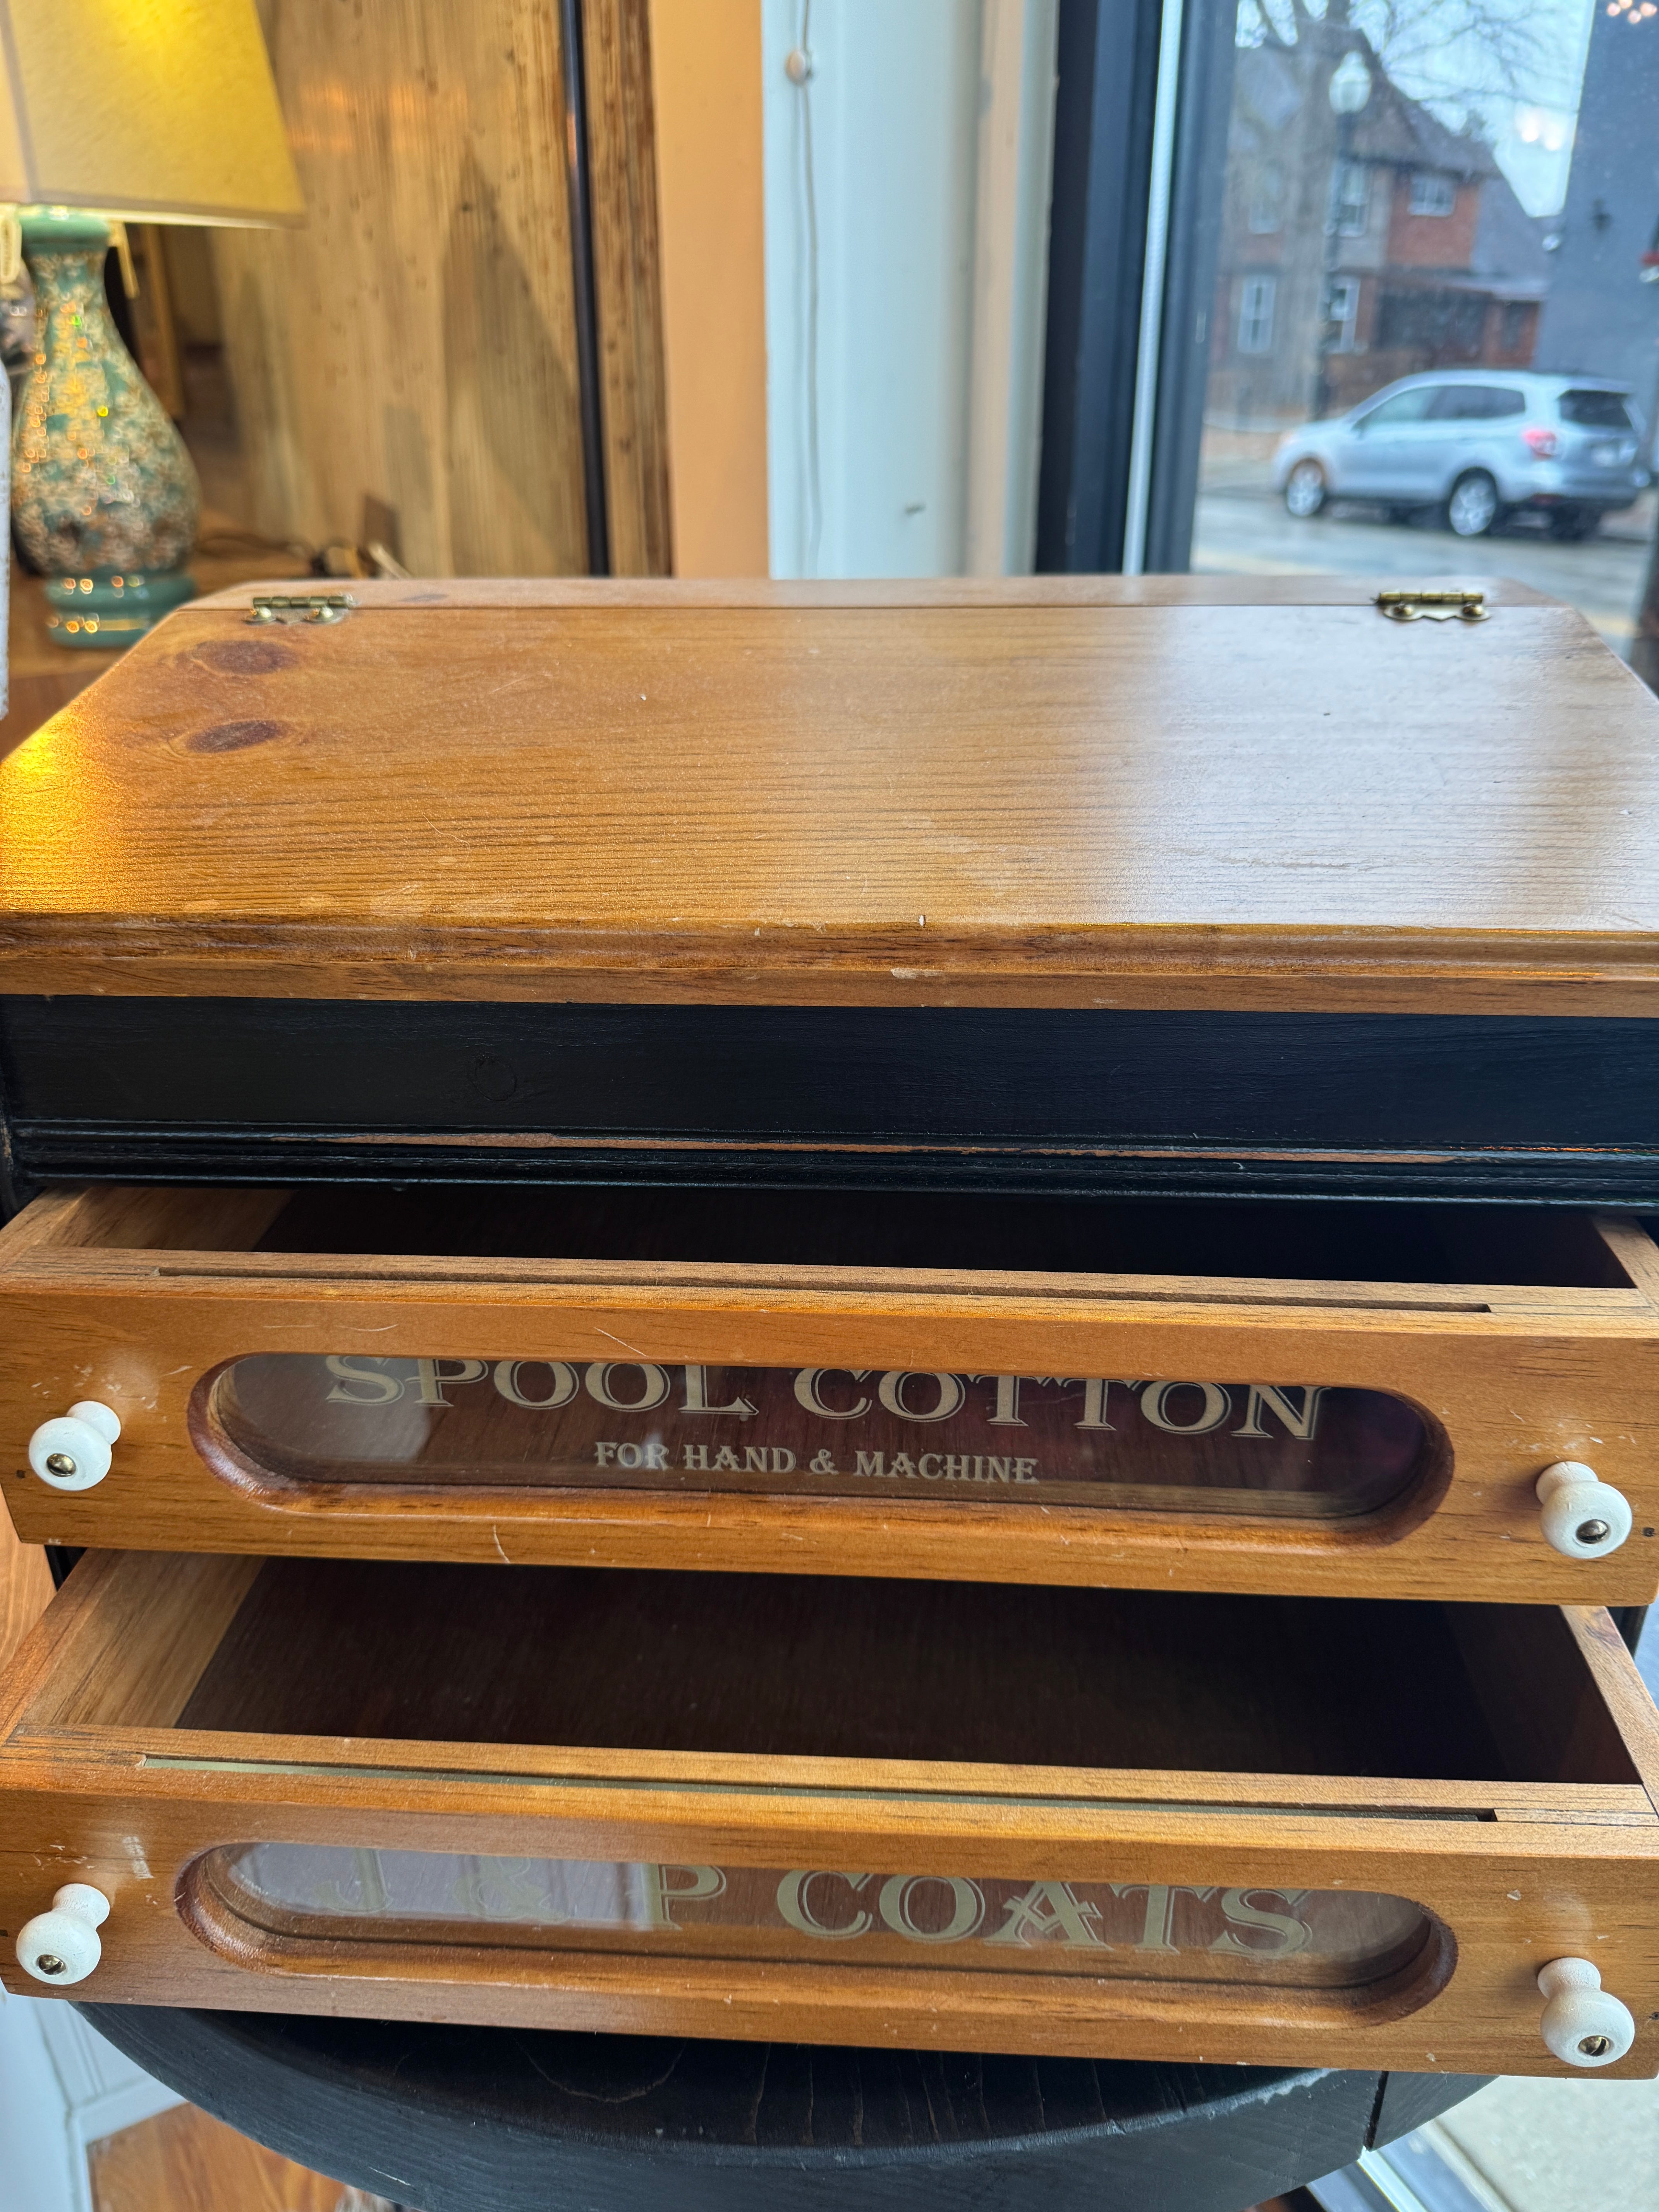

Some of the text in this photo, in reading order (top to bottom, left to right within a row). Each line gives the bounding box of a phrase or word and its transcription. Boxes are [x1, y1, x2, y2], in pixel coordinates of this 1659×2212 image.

[325, 1354, 1332, 1441] SPOOL COTTON
[595, 1440, 1039, 1484] FOR HAND & MACHINE
[627, 1862, 727, 1932] P
[776, 1870, 1314, 1961] COATS
